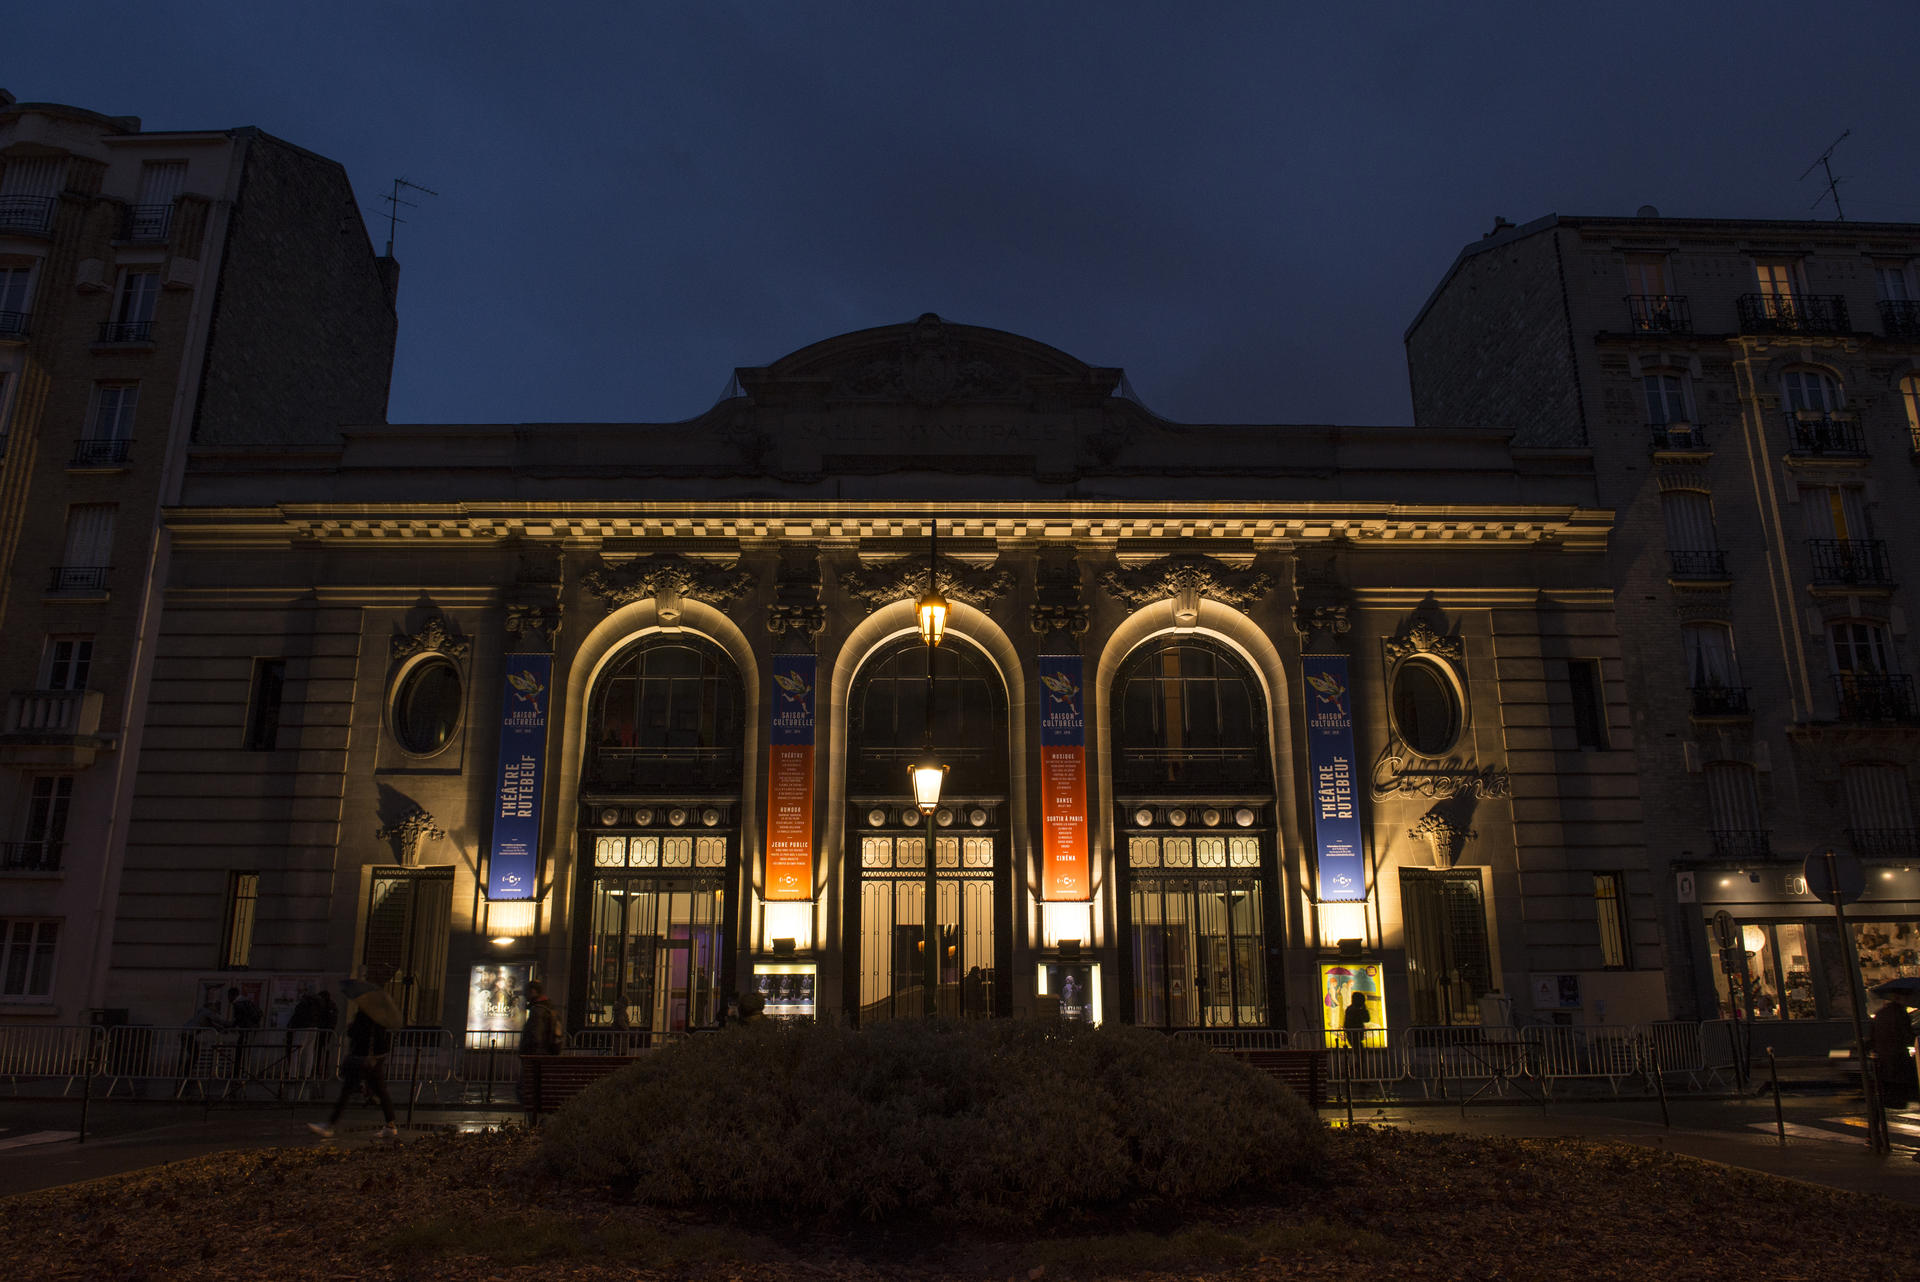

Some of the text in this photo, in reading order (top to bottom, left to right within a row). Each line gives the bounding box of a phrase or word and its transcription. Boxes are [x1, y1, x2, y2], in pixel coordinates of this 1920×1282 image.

[781, 711, 806, 719] SAISON
[1050, 712, 1075, 720] SAISON
[1318, 712, 1342, 720] SAISON
[504, 718, 545, 726] CULTURELLE
[773, 718, 814, 726] CULTURELLE
[1042, 719, 1084, 727] CULTURELLE
[1310, 719, 1352, 728] CULTURELLE
[517, 754, 536, 817] RUTEBEUF
[1333, 755, 1353, 819] RUTEBEUF
[500, 763, 520, 818] THÉÂTRE
[1317, 764, 1338, 820] THÉÂTRE
